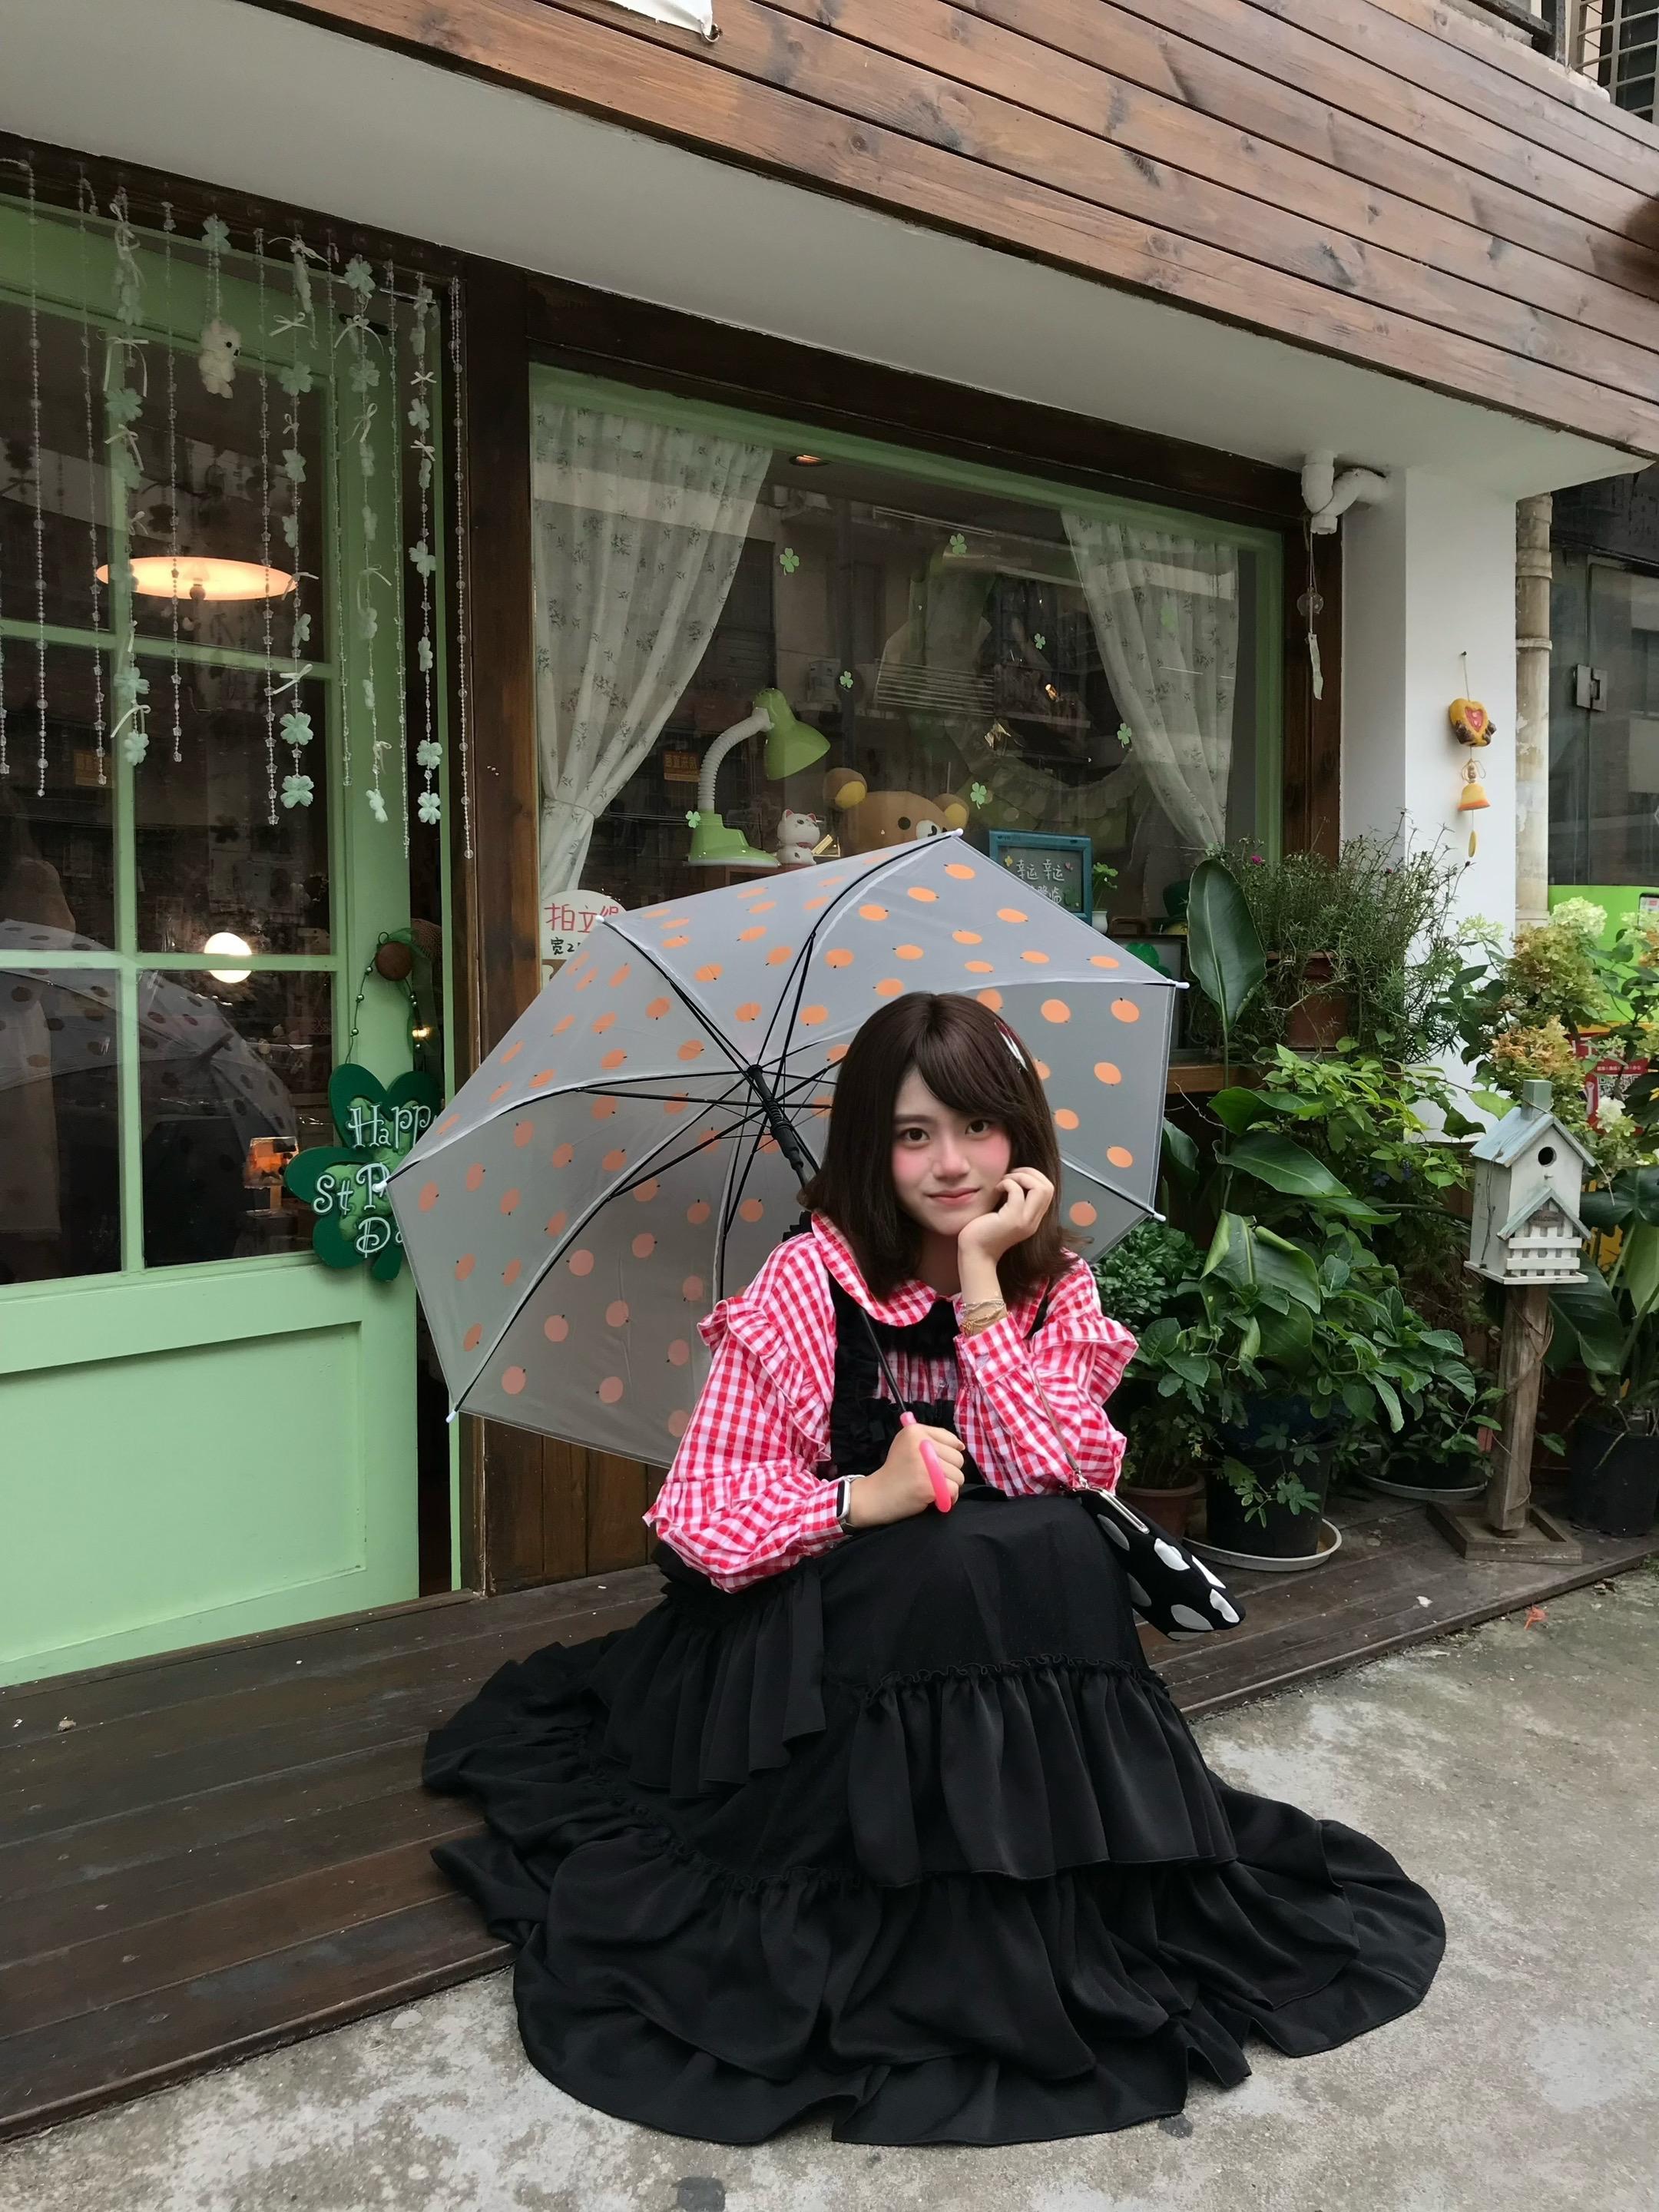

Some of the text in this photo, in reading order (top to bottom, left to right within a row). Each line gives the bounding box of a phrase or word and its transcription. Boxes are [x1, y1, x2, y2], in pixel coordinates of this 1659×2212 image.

[551, 937, 581, 955] 宽2
[347, 1104, 438, 1148] Happ
[313, 1175, 353, 1214] St
